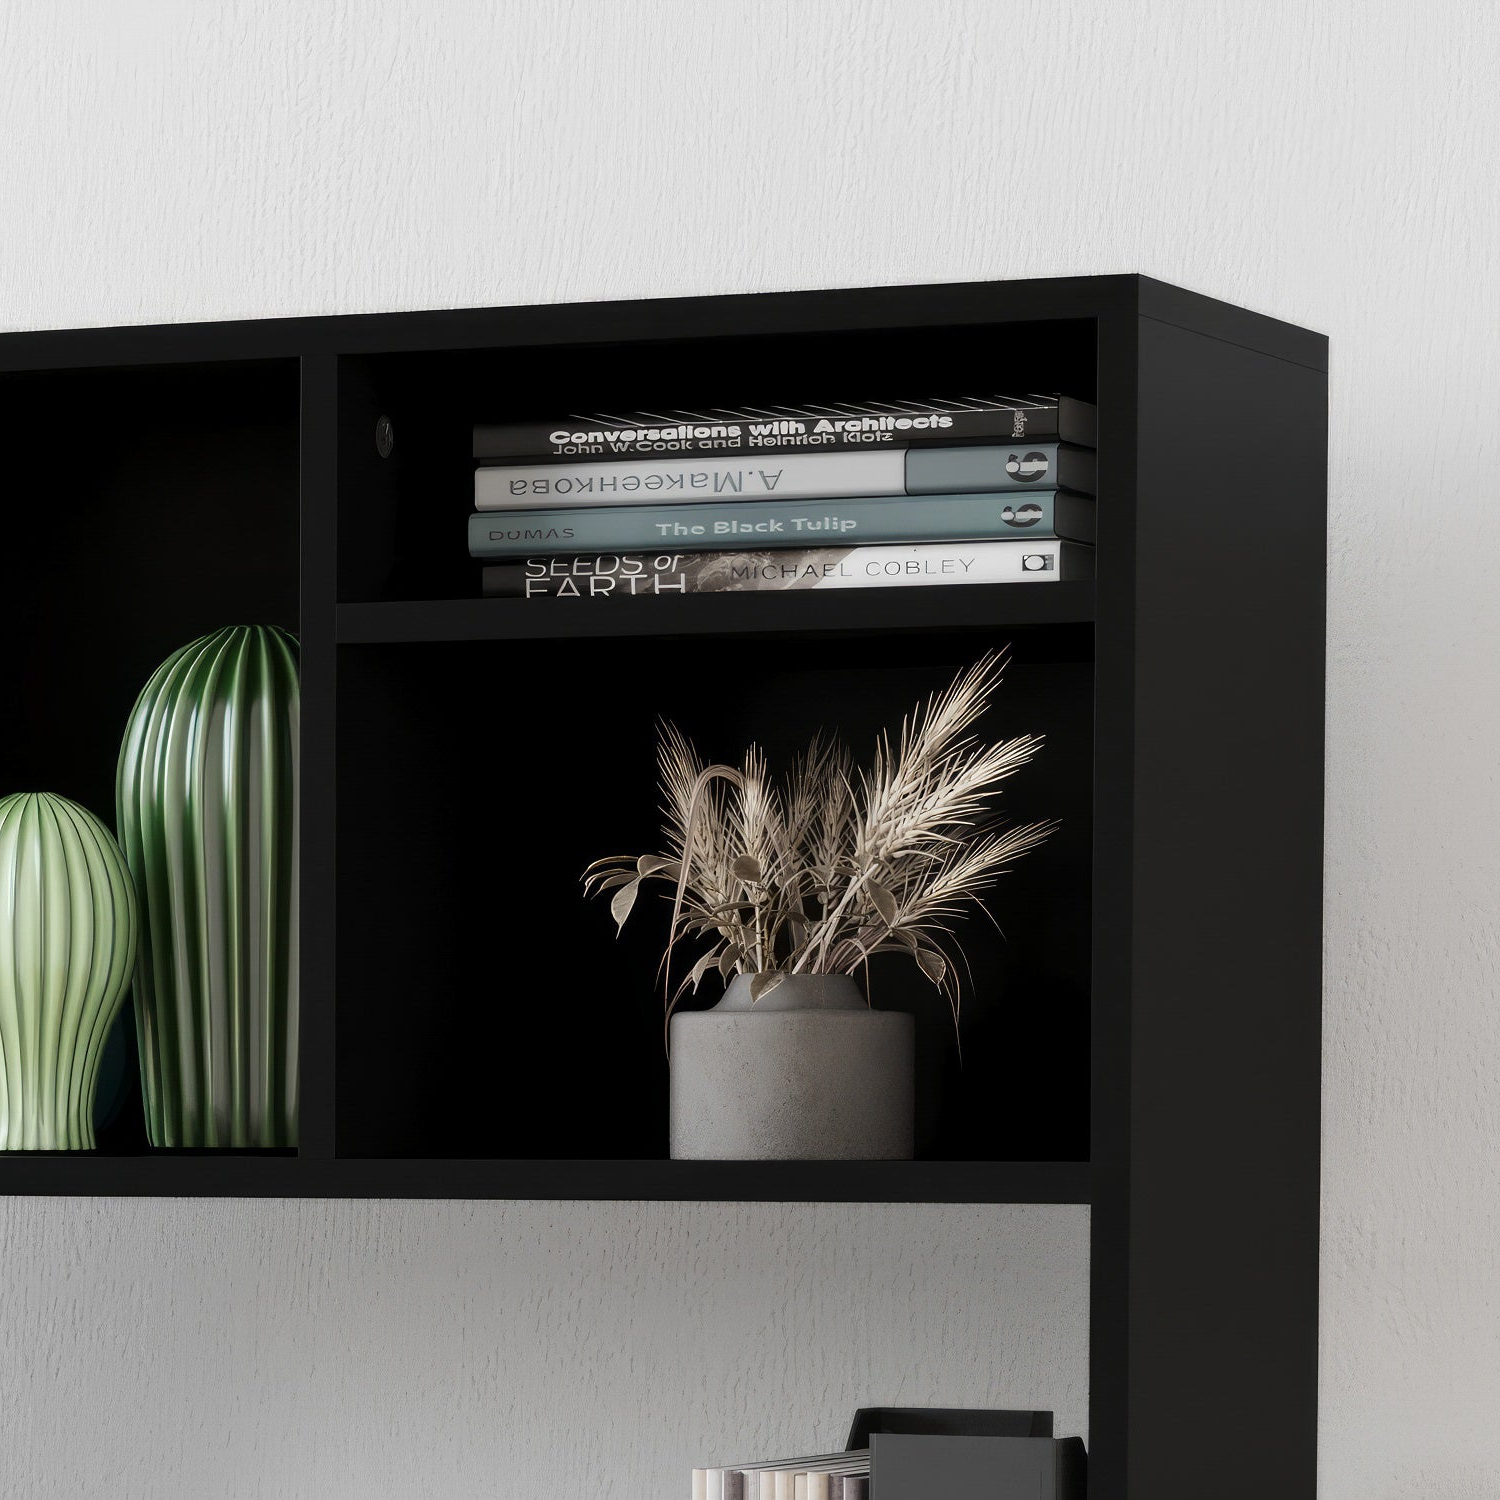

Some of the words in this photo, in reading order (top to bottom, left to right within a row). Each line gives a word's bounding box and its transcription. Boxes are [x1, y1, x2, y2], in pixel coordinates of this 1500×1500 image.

[549, 424, 742, 444] Conversations
[812, 414, 954, 434] Architects
[553, 444, 604, 455] John
[698, 436, 742, 449] and
[488, 527, 575, 541] DUMAS
[655, 522, 706, 537] The
[713, 518, 785, 535] Black
[791, 517, 858, 534] Tulip
[525, 554, 644, 578] SEEDS
[730, 561, 853, 580] MICHAEL
[864, 558, 977, 577] COBLEY
